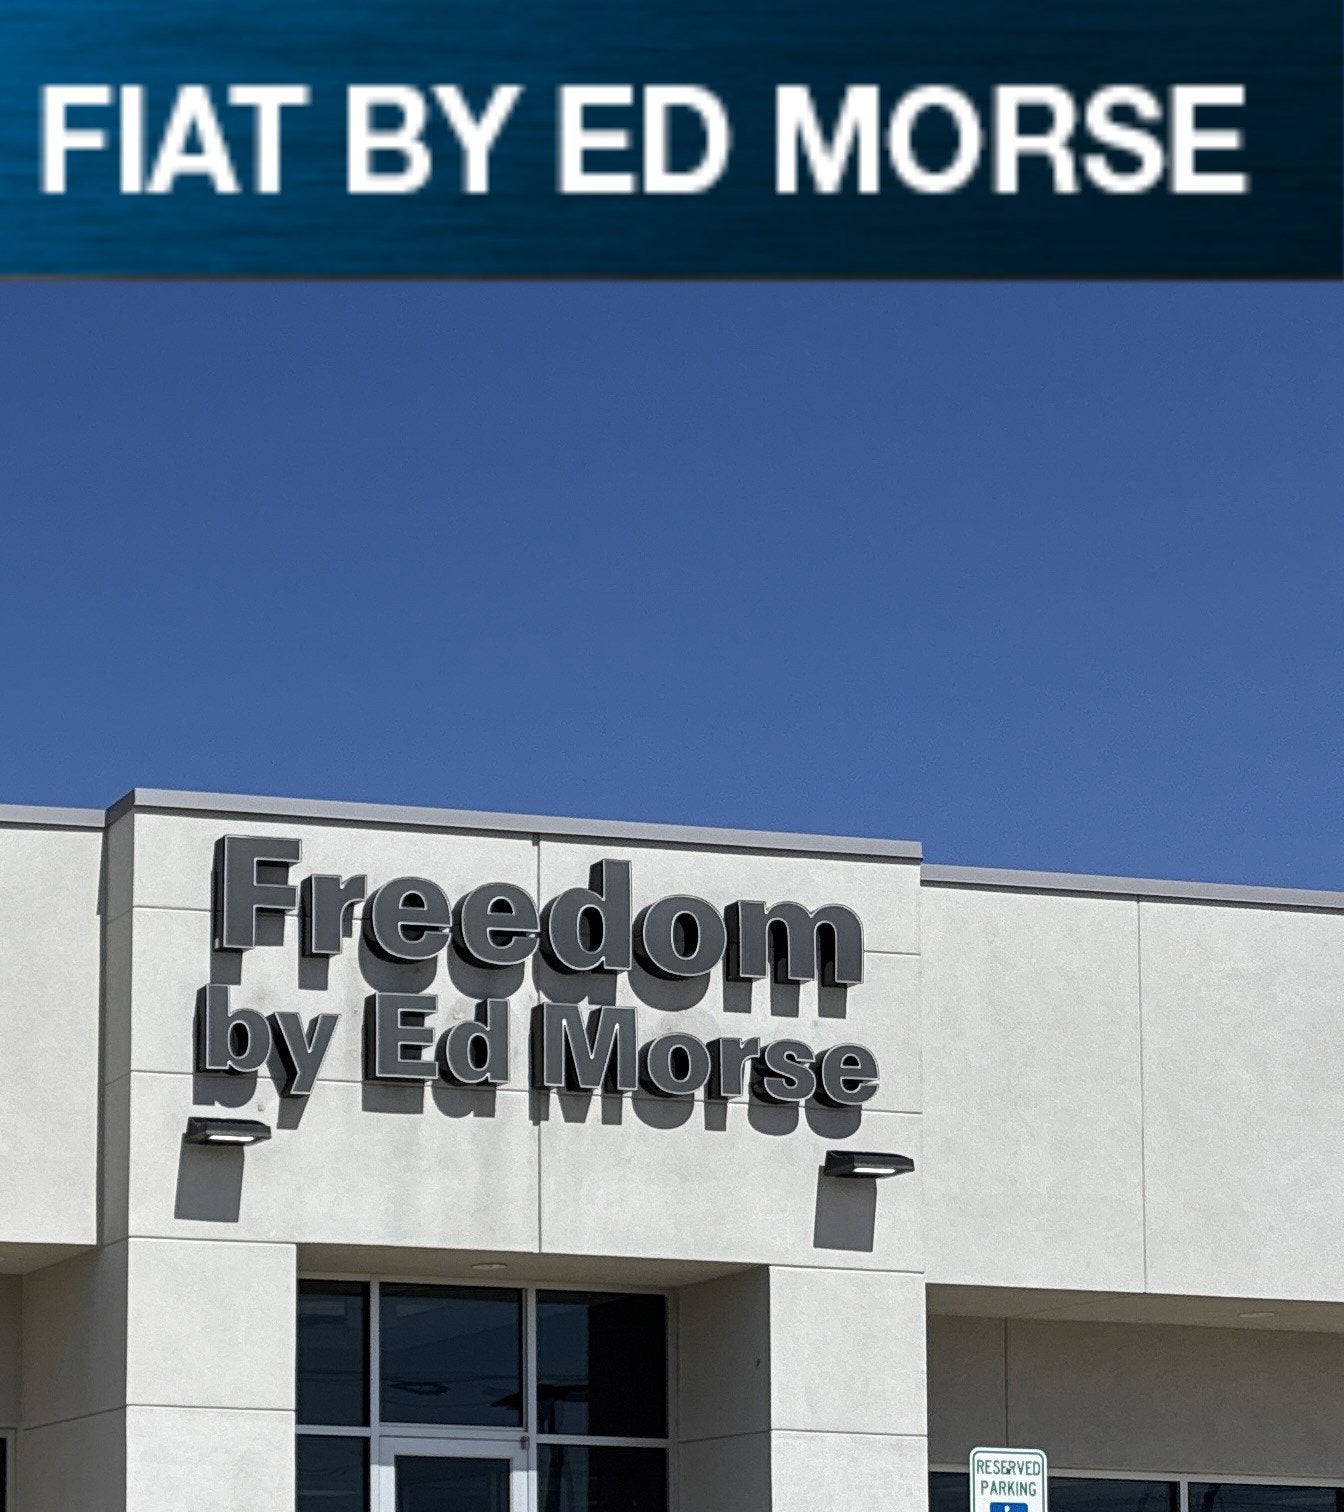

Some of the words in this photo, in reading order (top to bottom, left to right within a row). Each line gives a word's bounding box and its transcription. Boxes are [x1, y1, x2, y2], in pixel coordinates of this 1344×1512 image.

[213, 833, 865, 985] Freedom
[196, 982, 340, 1096] by
[369, 991, 511, 1085] Ed
[536, 1002, 881, 1105] Morse
[975, 1459, 1042, 1477] RESERVED
[980, 1480, 1038, 1497] PARKING
